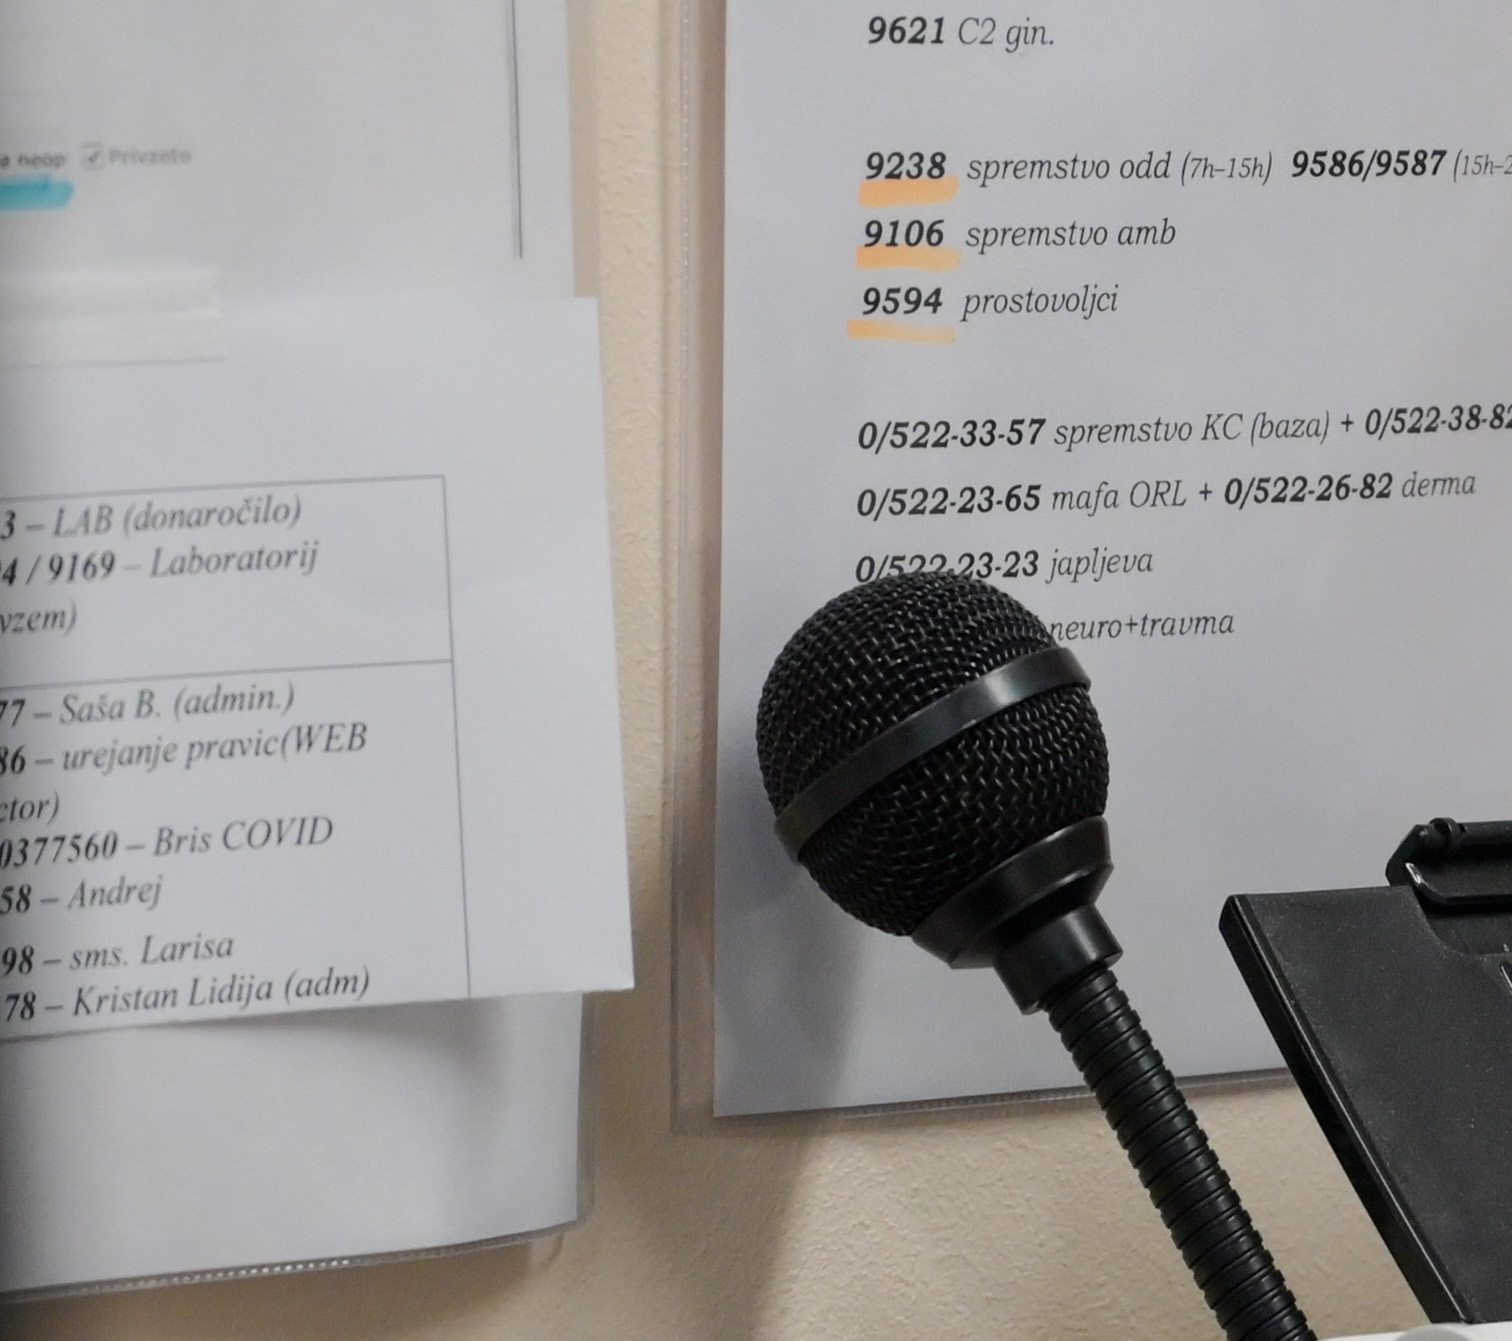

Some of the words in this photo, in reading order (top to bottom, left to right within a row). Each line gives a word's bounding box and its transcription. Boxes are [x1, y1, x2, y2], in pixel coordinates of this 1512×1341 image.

[868, 17, 946, 45] 9621
[958, 17, 998, 45] C2
[1005, 18, 1056, 54] gin.
[865, 151, 947, 180] 9238
[966, 152, 1110, 188] spremstvo
[1119, 151, 1171, 179] odd
[1291, 149, 1447, 183] 9586/9587
[864, 219, 945, 248] 9106
[965, 219, 1108, 255] spremstvo
[1117, 218, 1176, 246] amb
[862, 286, 943, 315] 9594
[960, 283, 1119, 321] prostovoljci
[858, 417, 1046, 455] 0/522-33-57
[1053, 412, 1193, 450] spremstvo
[1201, 412, 1243, 441] KC
[1251, 410, 1330, 447] (baza)
[1341, 414, 1354, 433] +
[50, 504, 112, 539] LAB
[122, 492, 302, 540] (donaročilo)
[856, 484, 1042, 522] 0/522-23-65
[1051, 481, 1119, 517] mafa
[1128, 480, 1187, 510] ORL
[1199, 482, 1213, 501] +
[1224, 472, 1393, 510] 0/522-26-82
[1401, 470, 1476, 499] derma
[47, 551, 117, 584] 9169
[149, 539, 319, 580] Laboratorij
[1045, 547, 1154, 584] japljeva
[1047, 610, 1235, 642] neuro+travma
[58, 691, 125, 725] Saša
[134, 688, 161, 718] B.
[173, 681, 295, 722] (admin.)
[62, 736, 178, 776] urejanje
[152, 824, 212, 859] Bris
[220, 815, 334, 850] COVID
[66, 876, 163, 915] Andrej
[69, 945, 128, 972] sms.
[139, 931, 234, 964] Larisa
[72, 982, 179, 1019] Kristan
[186, 970, 273, 1006] Lidija
[283, 965, 370, 1004] (adm)
